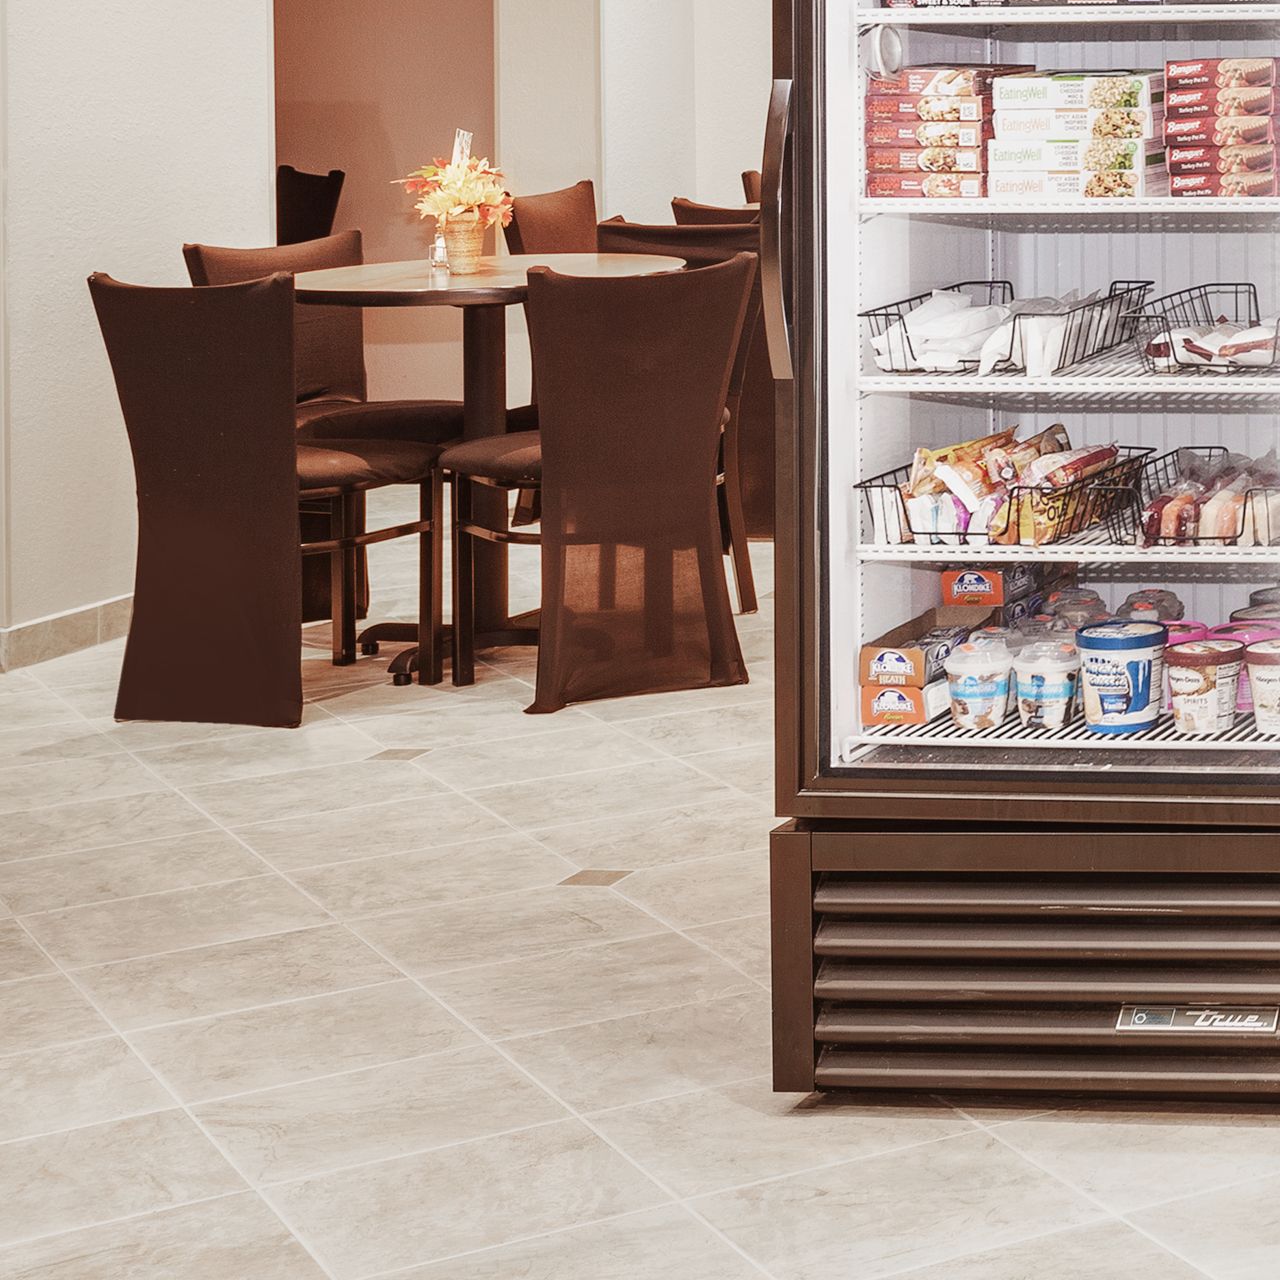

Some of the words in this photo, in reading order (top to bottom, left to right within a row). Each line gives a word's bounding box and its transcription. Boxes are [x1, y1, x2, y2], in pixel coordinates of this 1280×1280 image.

[1000, 87, 1047, 101] EatingWell
[1003, 119, 1050, 132] EatingWell
[994, 149, 1042, 163] EatingWell
[995, 180, 1043, 194] EatingWell
[953, 583, 993, 598] KLONDIKE
[1186, 1010, 1263, 1027] true
